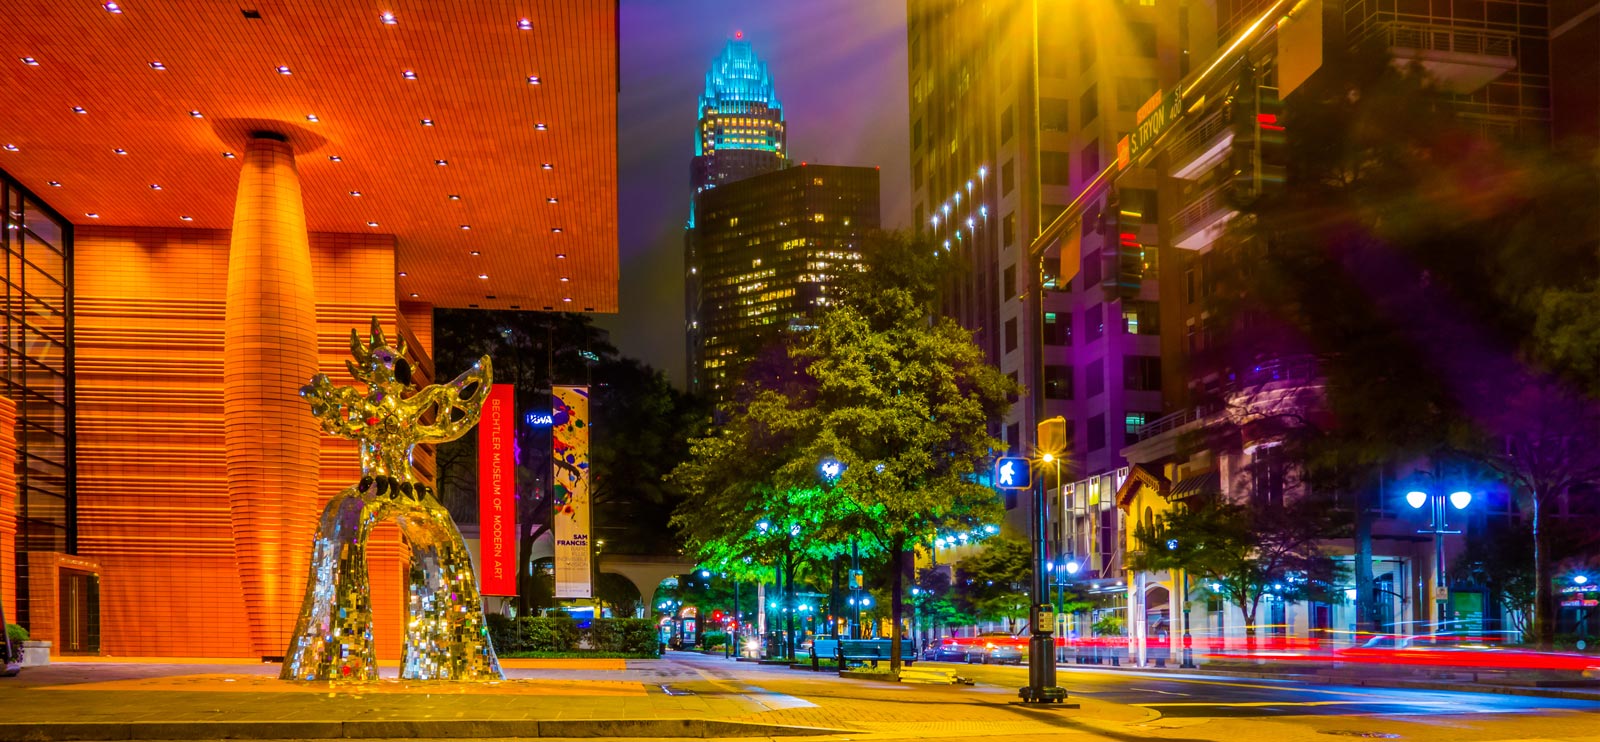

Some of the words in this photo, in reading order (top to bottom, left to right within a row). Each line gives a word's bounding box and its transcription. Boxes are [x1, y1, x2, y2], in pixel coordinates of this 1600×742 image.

[1131, 133, 1138, 153] S.
[1139, 105, 1165, 147] TRYON
[1170, 99, 1182, 119] 400
[492, 400, 501, 450] BECHTLER
[493, 454, 502, 495] MUSEUM
[494, 498, 502, 511] OF
[494, 516, 503, 557] MODERN
[494, 561, 503, 579] ART
